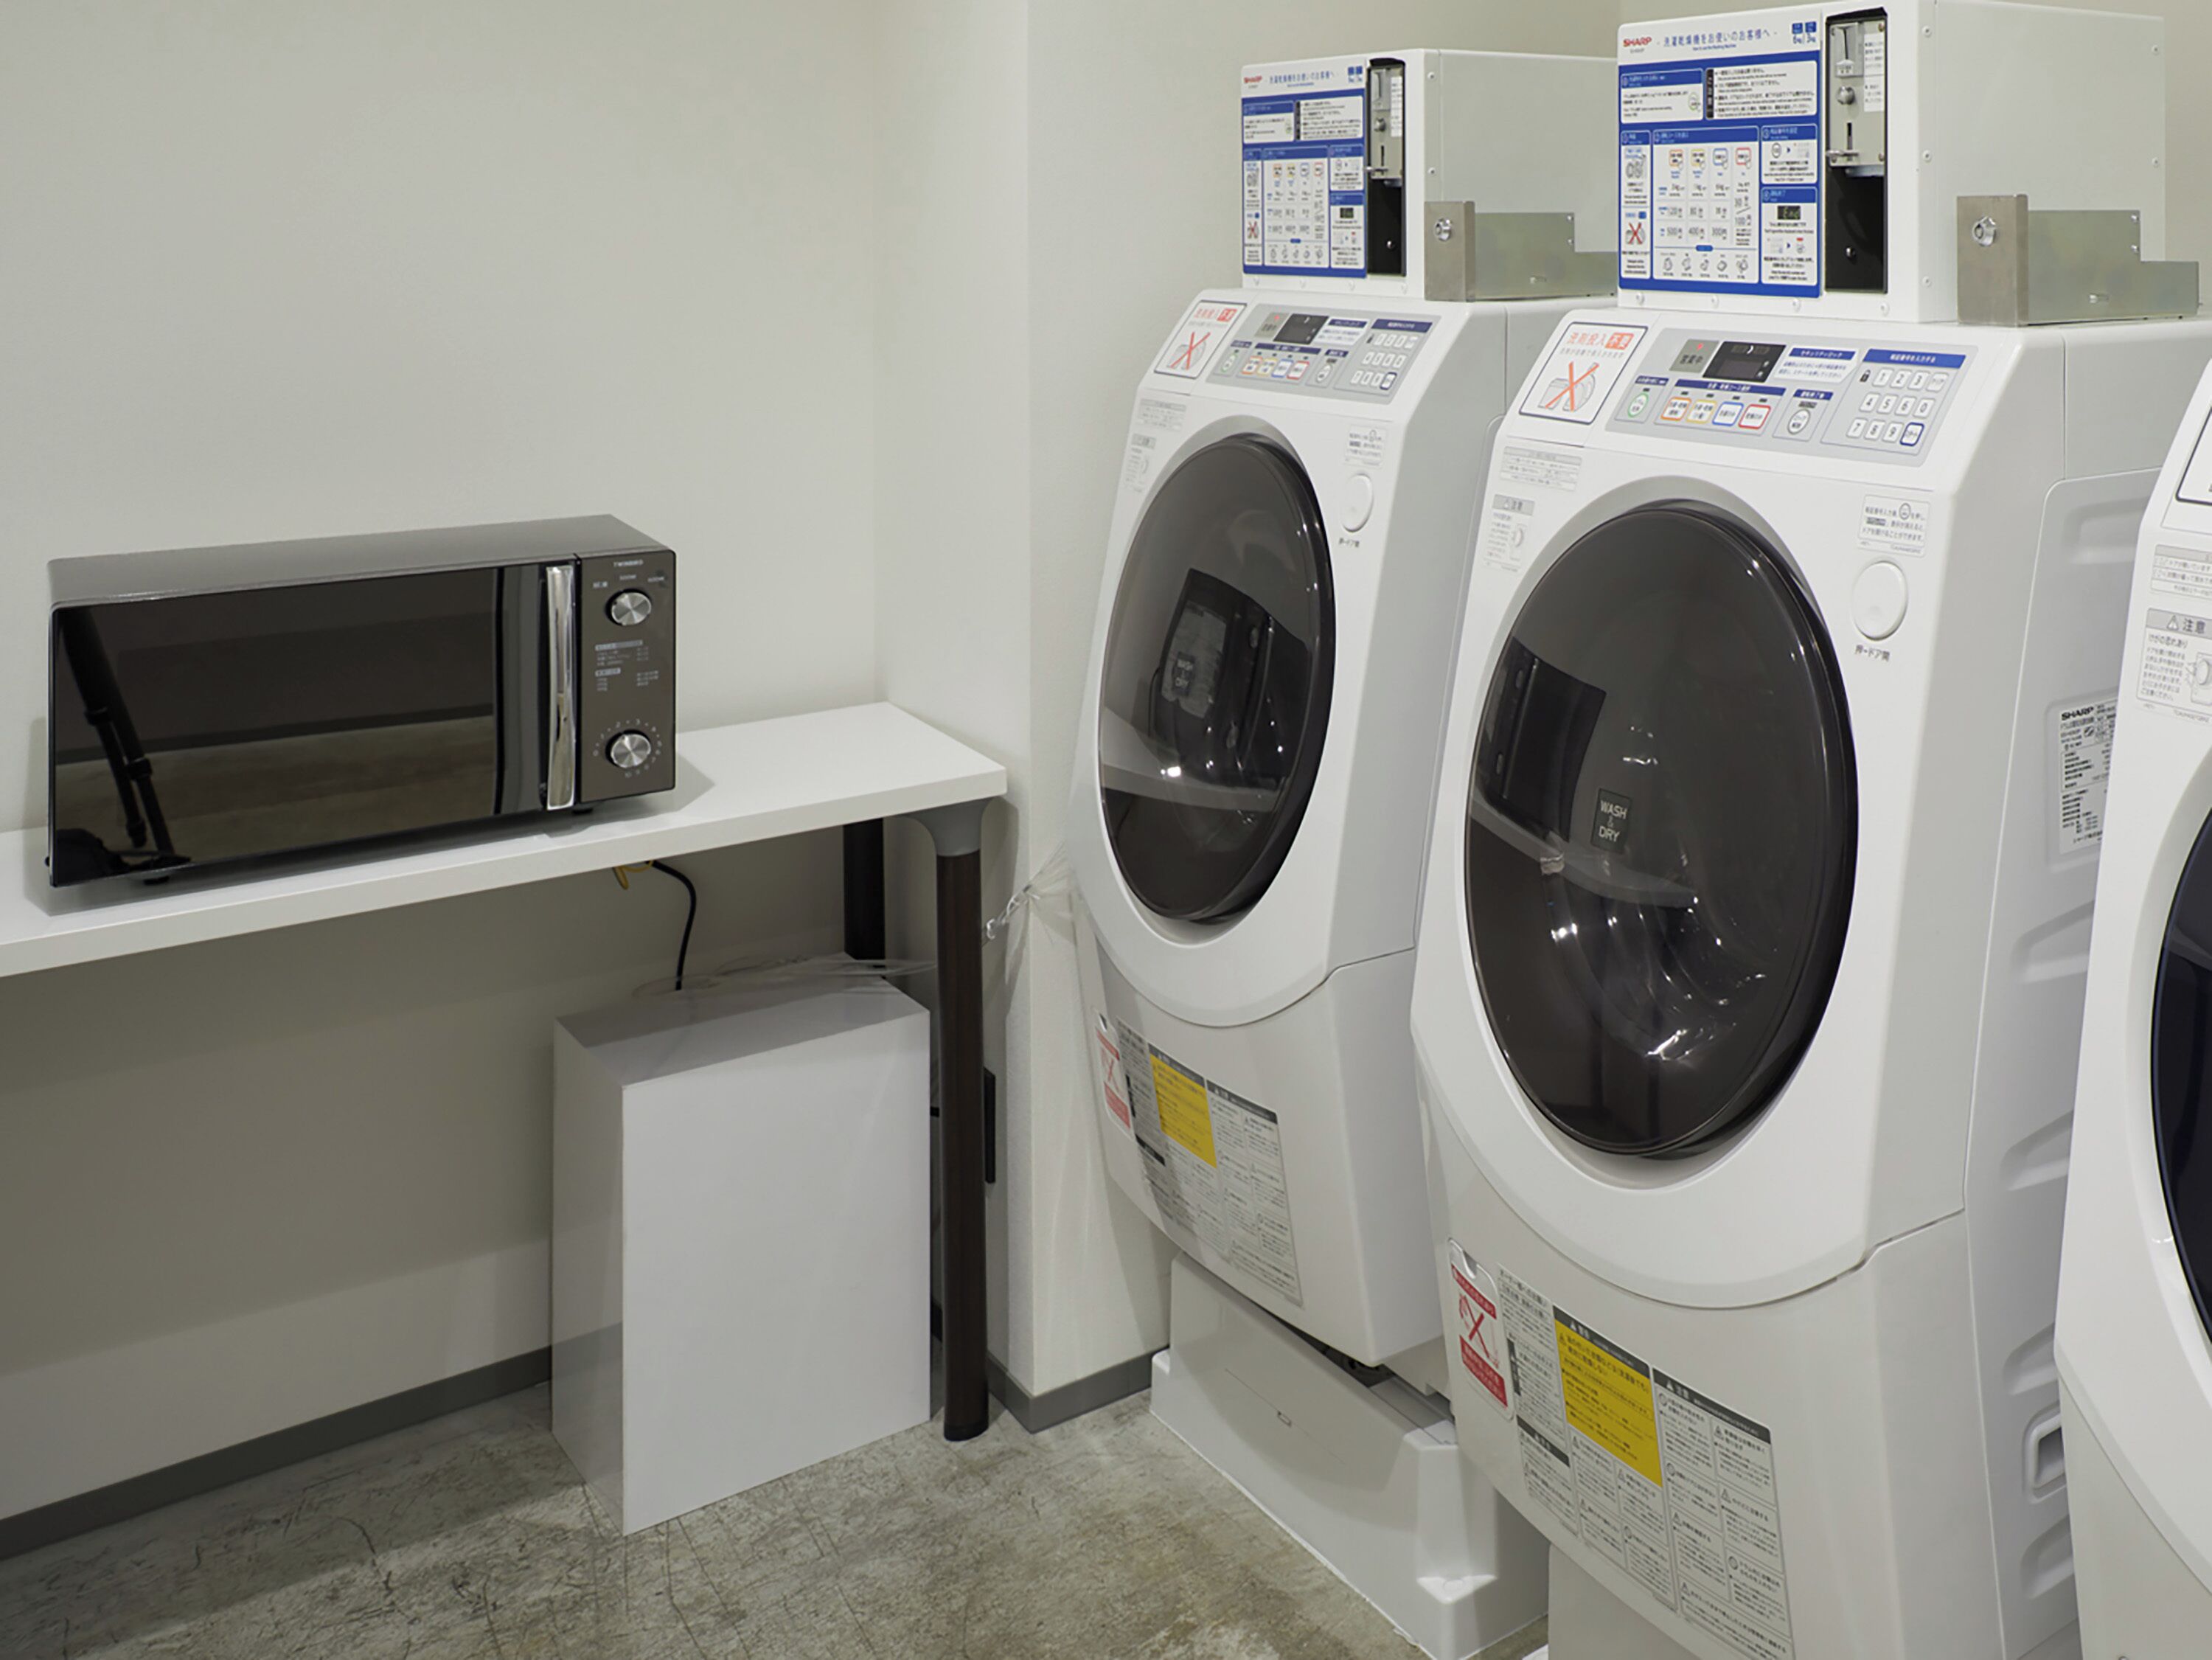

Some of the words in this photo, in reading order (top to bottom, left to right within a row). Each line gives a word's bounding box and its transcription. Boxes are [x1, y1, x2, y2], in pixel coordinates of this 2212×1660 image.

[1623, 37, 1652, 47] SHARP
[1896, 375, 1905, 383] 2
[1915, 376, 1922, 385] 3
[1883, 400, 1891, 409] 5
[1902, 402, 1908, 411] 6
[1853, 423, 1861, 432] 7
[1870, 426, 1878, 434] 8
[1888, 428, 1896, 437] 9
[2183, 618, 2205, 634] 注意
[2061, 706, 2094, 720] SHARP
[1599, 800, 1628, 819] WASH
[1599, 826, 1621, 842] DRY
